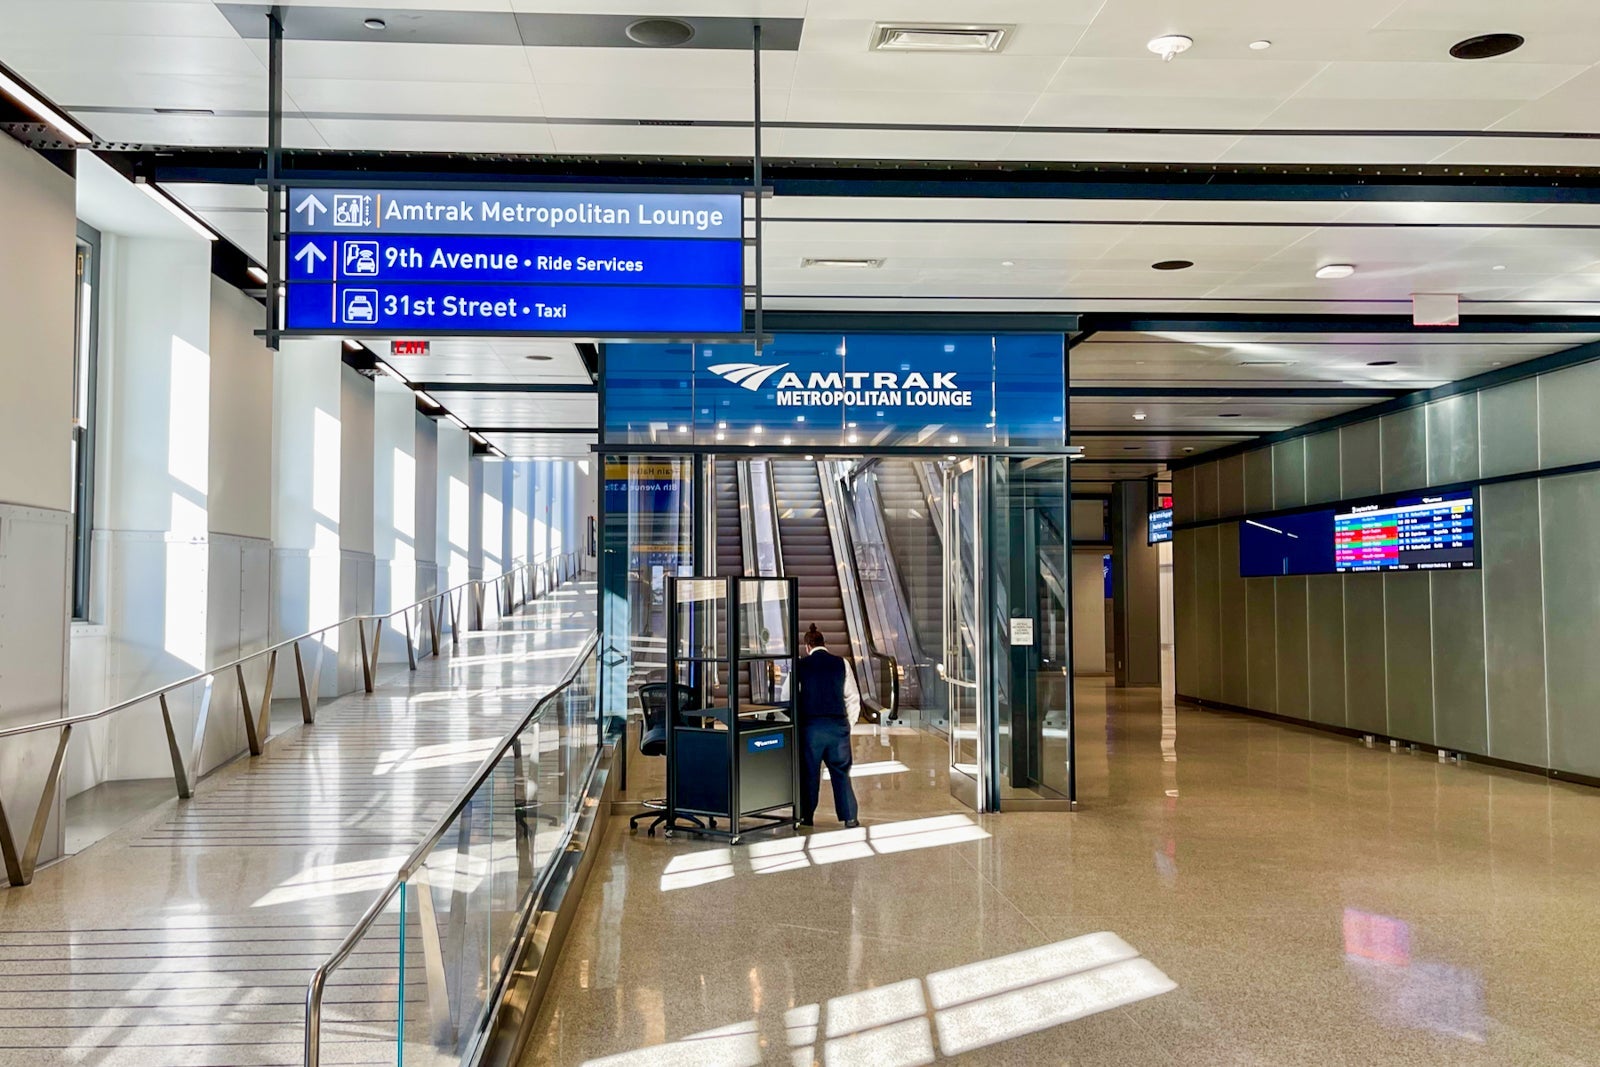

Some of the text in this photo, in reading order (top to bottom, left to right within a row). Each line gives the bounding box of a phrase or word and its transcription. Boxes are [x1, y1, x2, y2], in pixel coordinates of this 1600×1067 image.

[385, 199, 724, 230] Amtrak Metropolitan Lounge
[385, 247, 644, 272] 9th Avenue Ride Services
[384, 295, 567, 318] 31st Street Taxi
[776, 372, 958, 389] AMTRAK
[776, 390, 972, 407] METROPOLITAN LOUNGE
